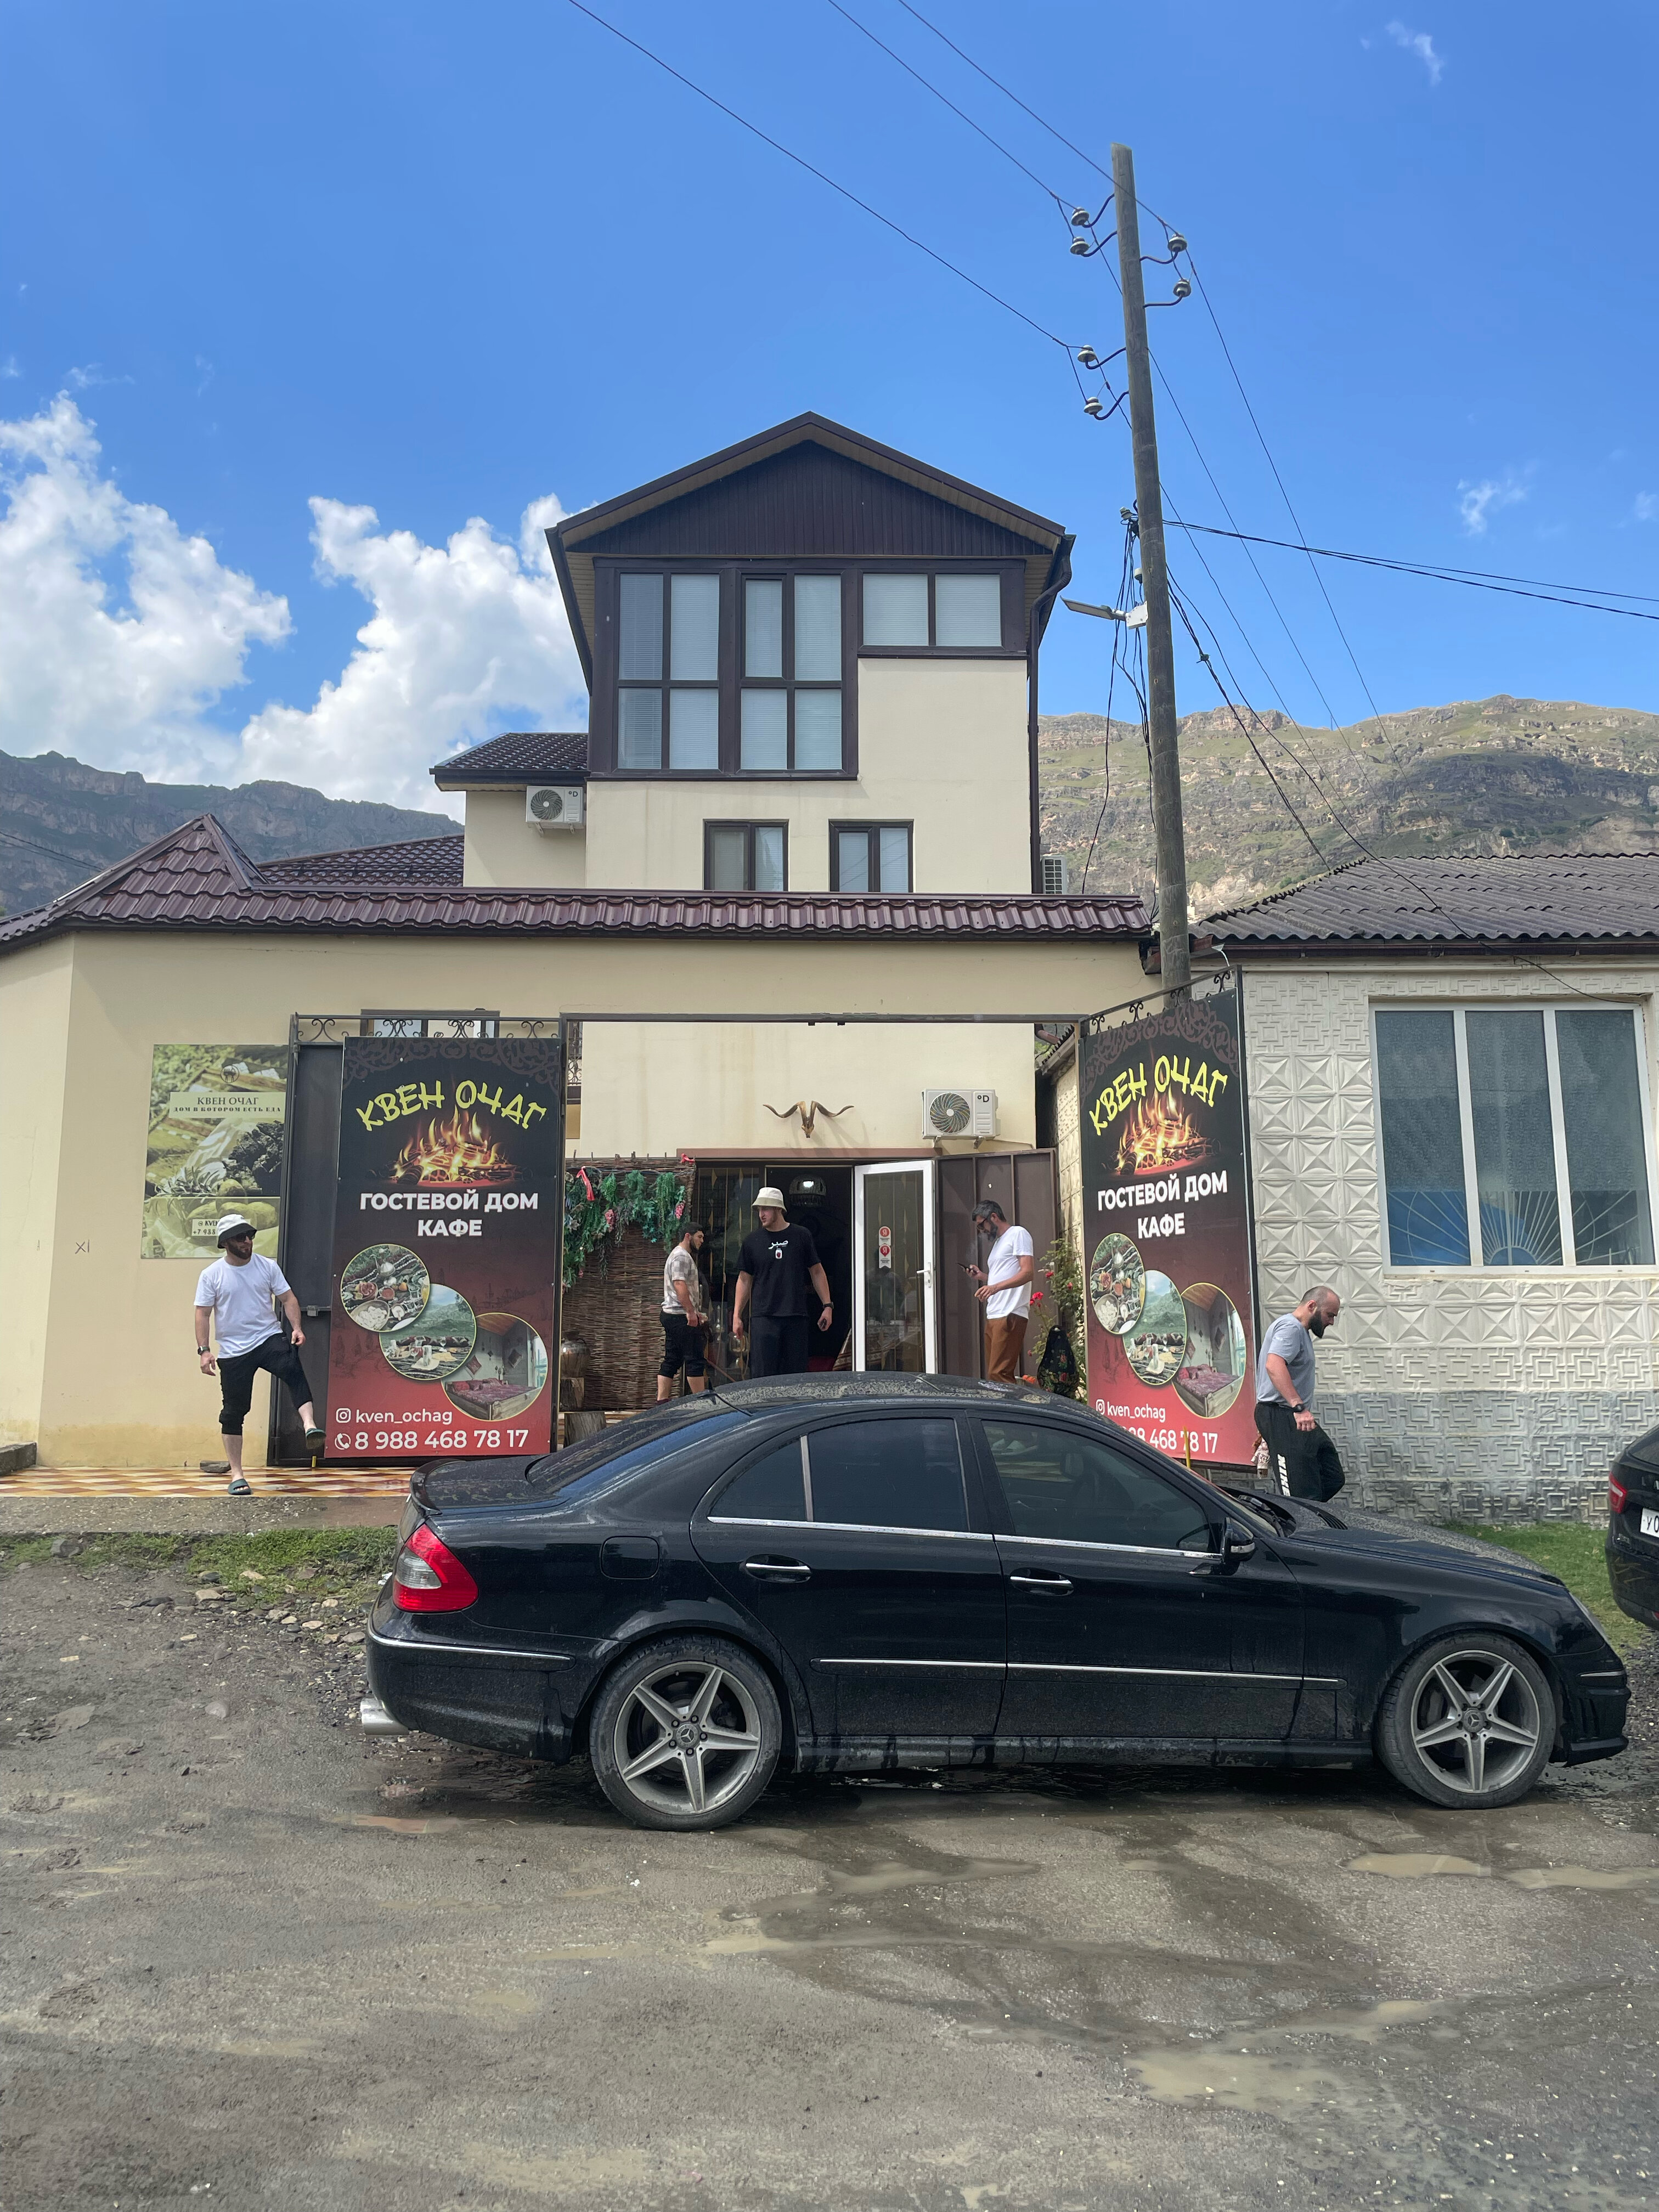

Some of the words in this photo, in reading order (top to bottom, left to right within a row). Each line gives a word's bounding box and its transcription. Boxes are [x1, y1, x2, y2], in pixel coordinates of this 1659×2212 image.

[356, 1080, 445, 1131] КВЕН
[455, 1080, 547, 1129] ОЧАГ
[1089, 1063, 1147, 1136] КВЕН
[1154, 1055, 1228, 1107] ОЧАГ
[360, 1189, 478, 1210] ГОСТЕВОЙ
[484, 1193, 538, 1212] ДОМ
[1098, 1173, 1180, 1211] ГОСТЕВОЙ
[1184, 1170, 1228, 1202] ДОМ
[417, 1219, 482, 1237] КАФЕ
[1138, 1212, 1186, 1239] КАФЕ
[356, 1409, 453, 1425] kven_ochag
[1107, 1402, 1166, 1423] kven_ochag
[354, 1431, 369, 1450] 8
[375, 1431, 418, 1449] 988
[424, 1430, 467, 1448] 468
[473, 1430, 501, 1448] 78
[506, 1429, 529, 1447] 17
[1149, 1428, 1177, 1450] 468
[1202, 1432, 1218, 1454] 17
[1277, 1454, 1291, 1497] NIKE
